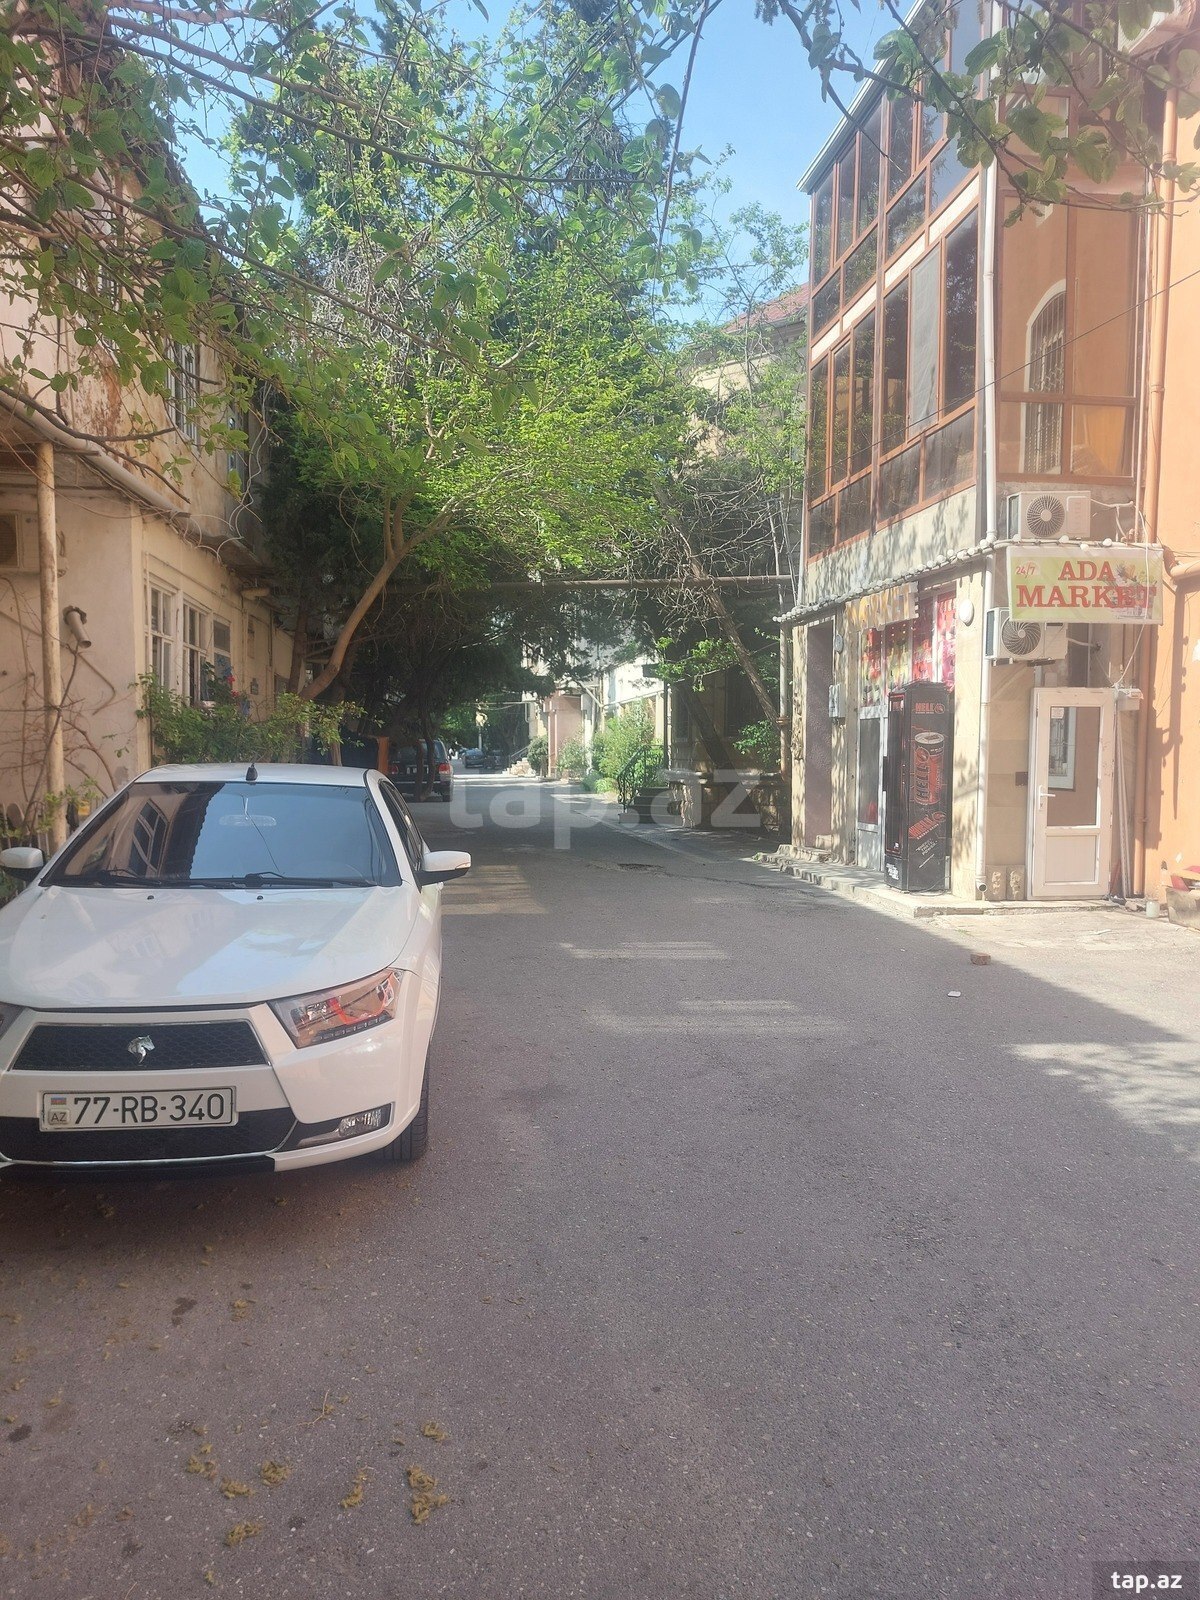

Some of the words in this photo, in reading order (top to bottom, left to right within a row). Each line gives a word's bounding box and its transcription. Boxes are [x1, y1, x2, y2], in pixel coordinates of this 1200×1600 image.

[1016, 561, 1036, 578] 24/7
[1058, 560, 1116, 581] ADA
[1016, 585, 1157, 609] MARKET
[50, 1112, 67, 1123] AZ
[74, 1093, 224, 1124] 77-RB-340
